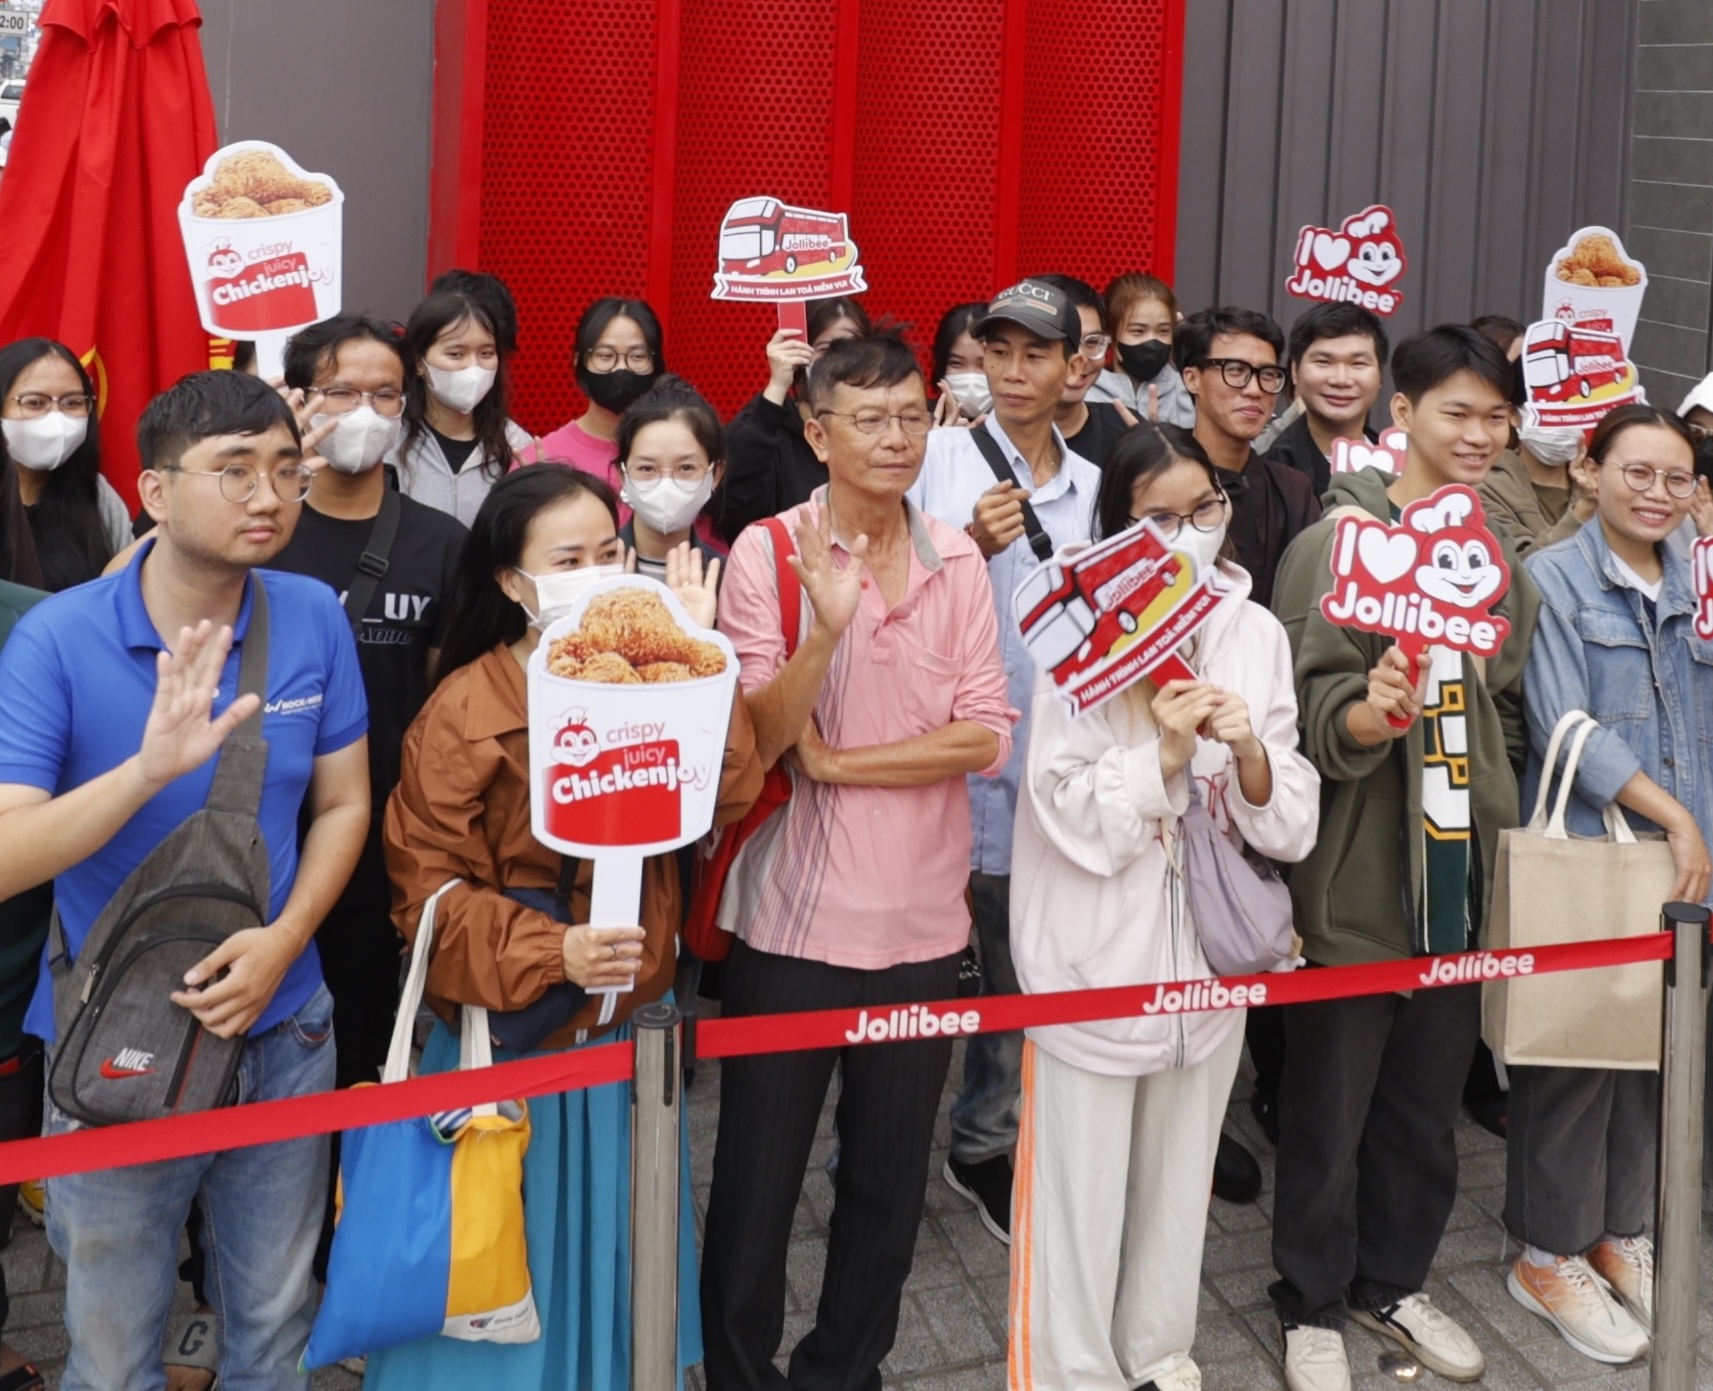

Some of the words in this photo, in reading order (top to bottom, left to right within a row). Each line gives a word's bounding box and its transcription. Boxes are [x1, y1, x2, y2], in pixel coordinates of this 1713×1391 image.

[248, 241, 293, 259] crispy
[785, 238, 829, 250] Jollibee
[264, 258, 296, 275] juicy
[213, 265, 334, 305] Chickenjoy
[780, 286, 797, 295] LAN
[998, 283, 1050, 301] GUCCI
[1291, 269, 1394, 312] Jollibee
[1338, 521, 1357, 576] I
[1106, 565, 1155, 606] Jollibee
[1329, 581, 1496, 650] Jollibee
[606, 722, 665, 744] crispy
[623, 746, 665, 770] juicy
[552, 757, 711, 804] Chickenjoy
[1419, 953, 1534, 985] Jollibee
[1142, 980, 1267, 1014] Jollibee
[845, 1004, 980, 1043] Jollibee
[113, 1047, 154, 1071] NIKE
